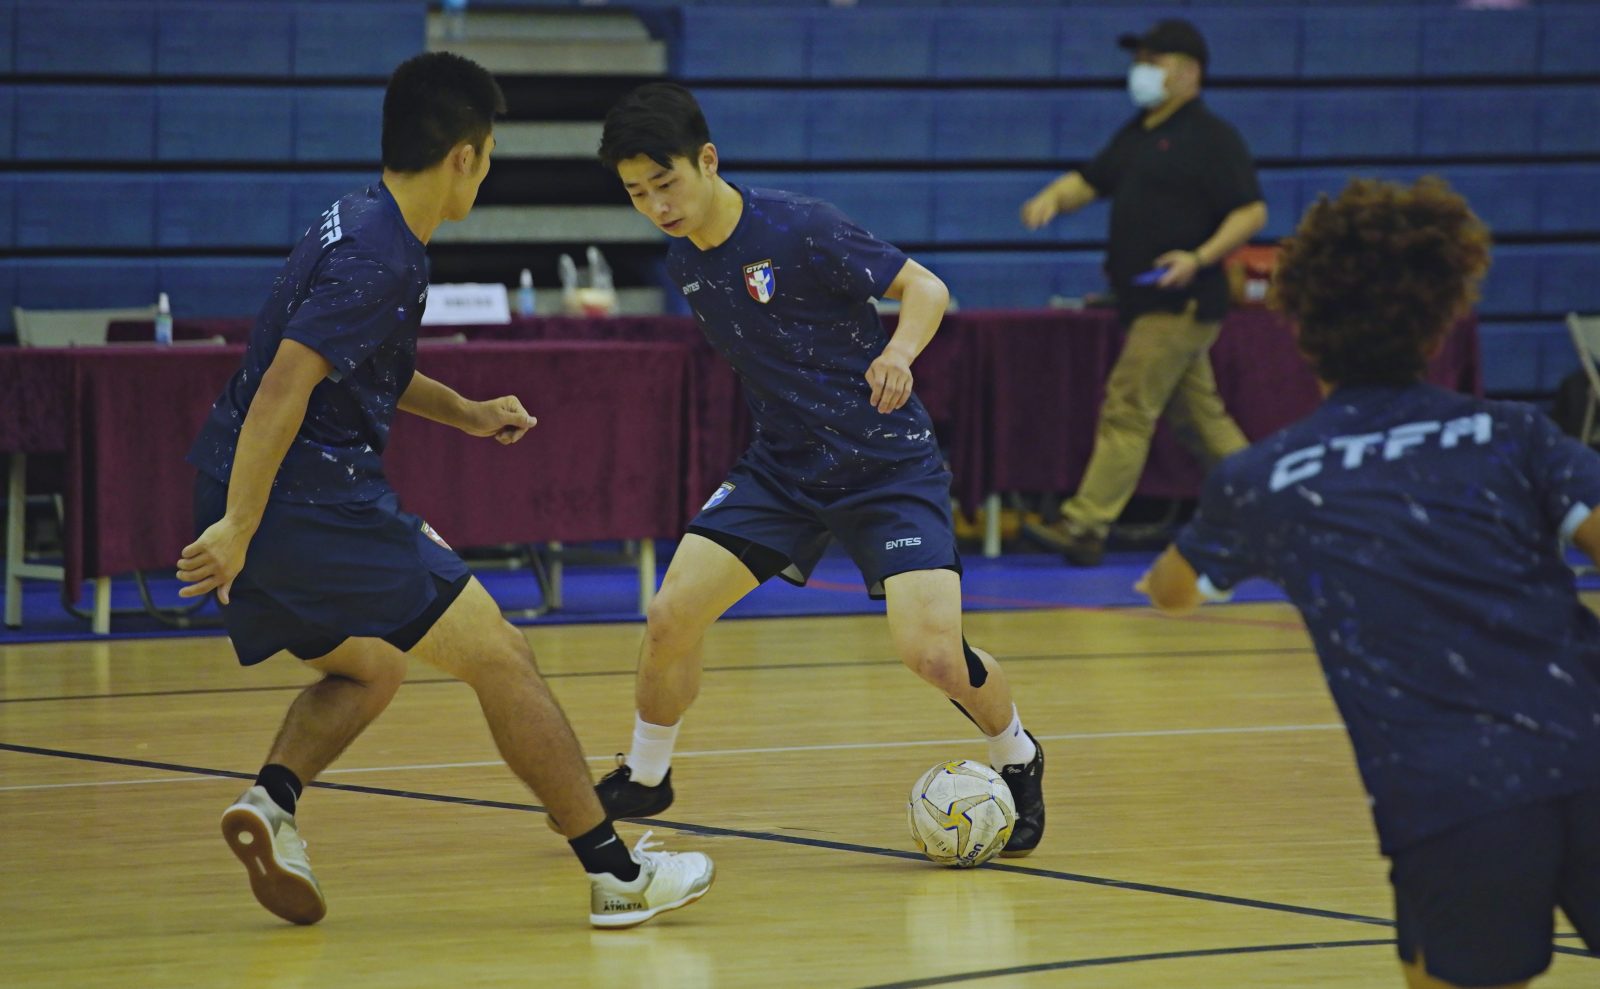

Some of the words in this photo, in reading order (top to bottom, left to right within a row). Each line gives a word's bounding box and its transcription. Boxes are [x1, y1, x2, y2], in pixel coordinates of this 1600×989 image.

[319, 199, 343, 249] TFA
[746, 261, 769, 273] CTFA
[1269, 412, 1492, 492] CTFA
[885, 537, 921, 550] ENTES
[603, 902, 642, 912] ATHLETA
